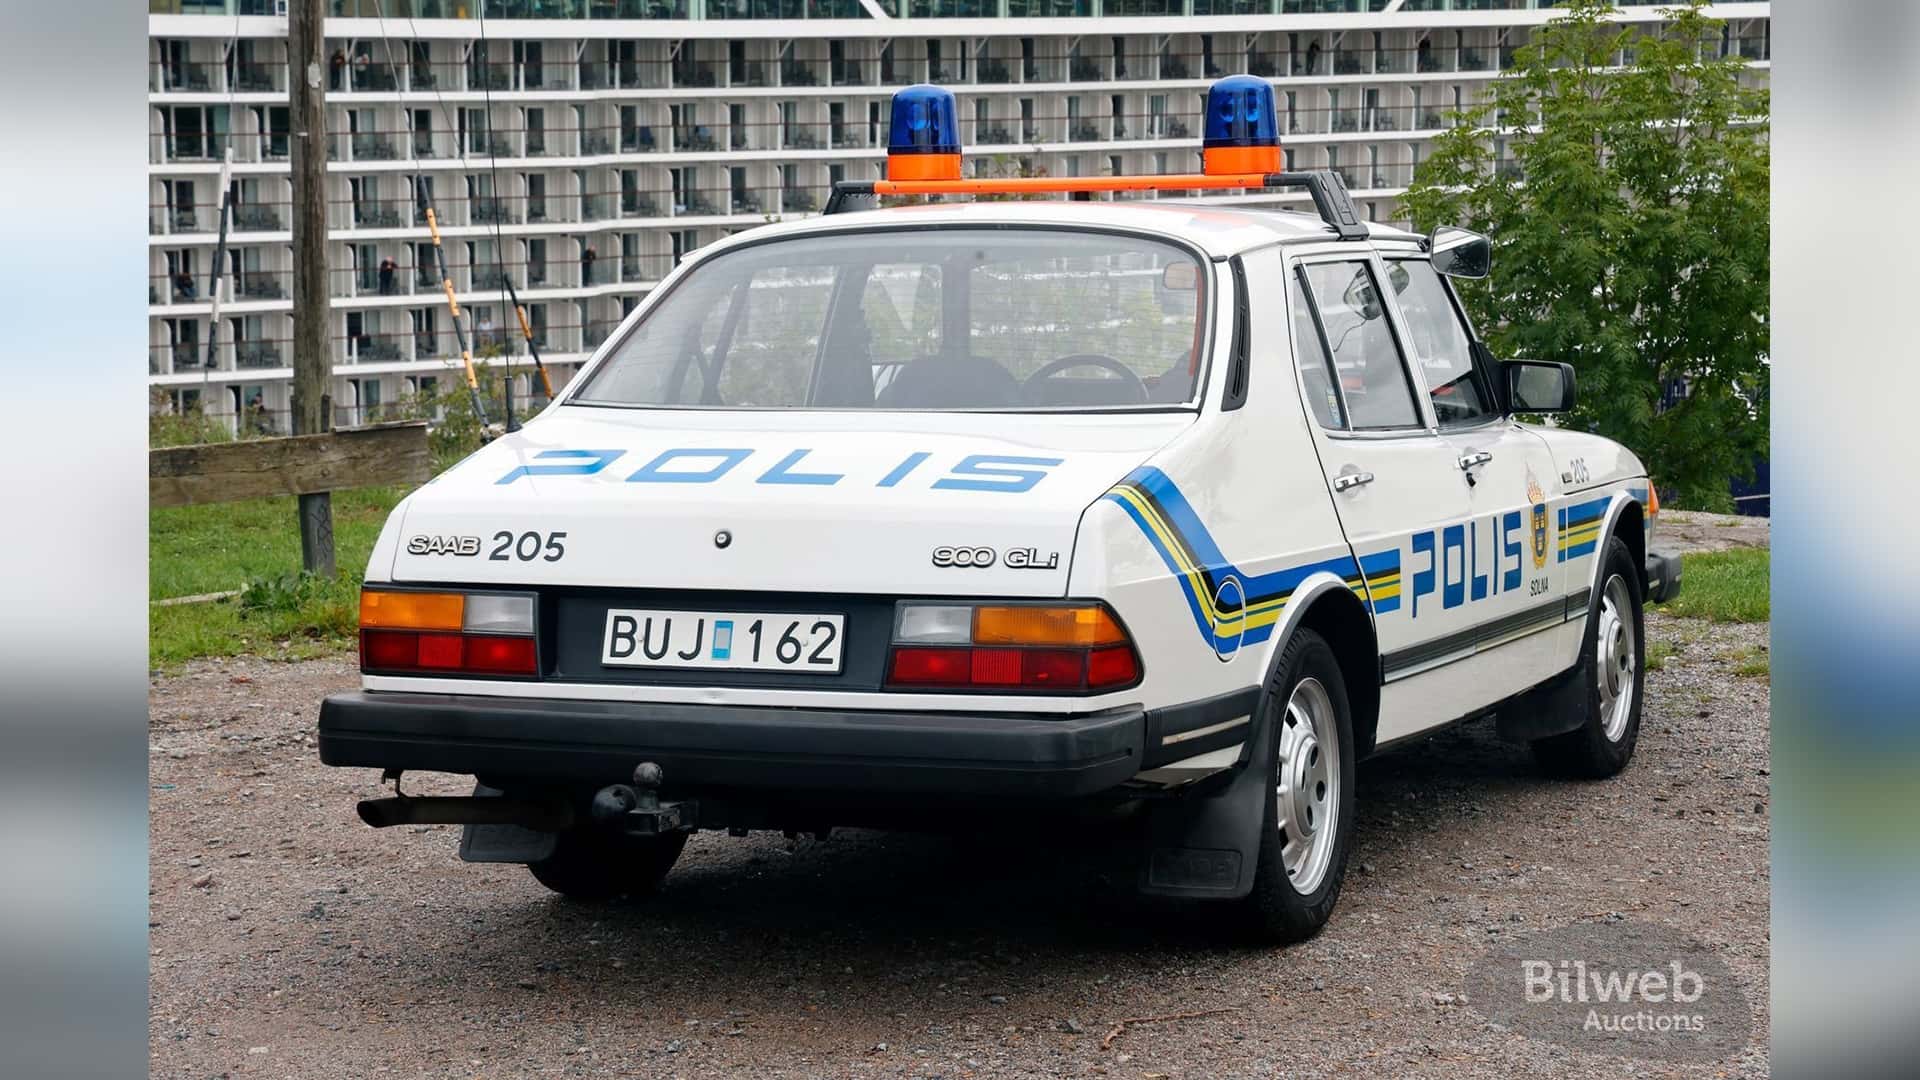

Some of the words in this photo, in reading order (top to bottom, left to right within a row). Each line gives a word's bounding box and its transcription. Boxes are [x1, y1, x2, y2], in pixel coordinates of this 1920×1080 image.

[494, 448, 1065, 493] POLIS
[1570, 457, 1589, 484] 205
[407, 534, 481, 556] SAAB
[488, 531, 567, 561] 205
[931, 546, 997, 568] 900
[1412, 510, 1522, 618] POLIS
[1530, 577, 1549, 596] SOLNA
[609, 615, 705, 661] BUJ
[748, 619, 838, 665] 162
